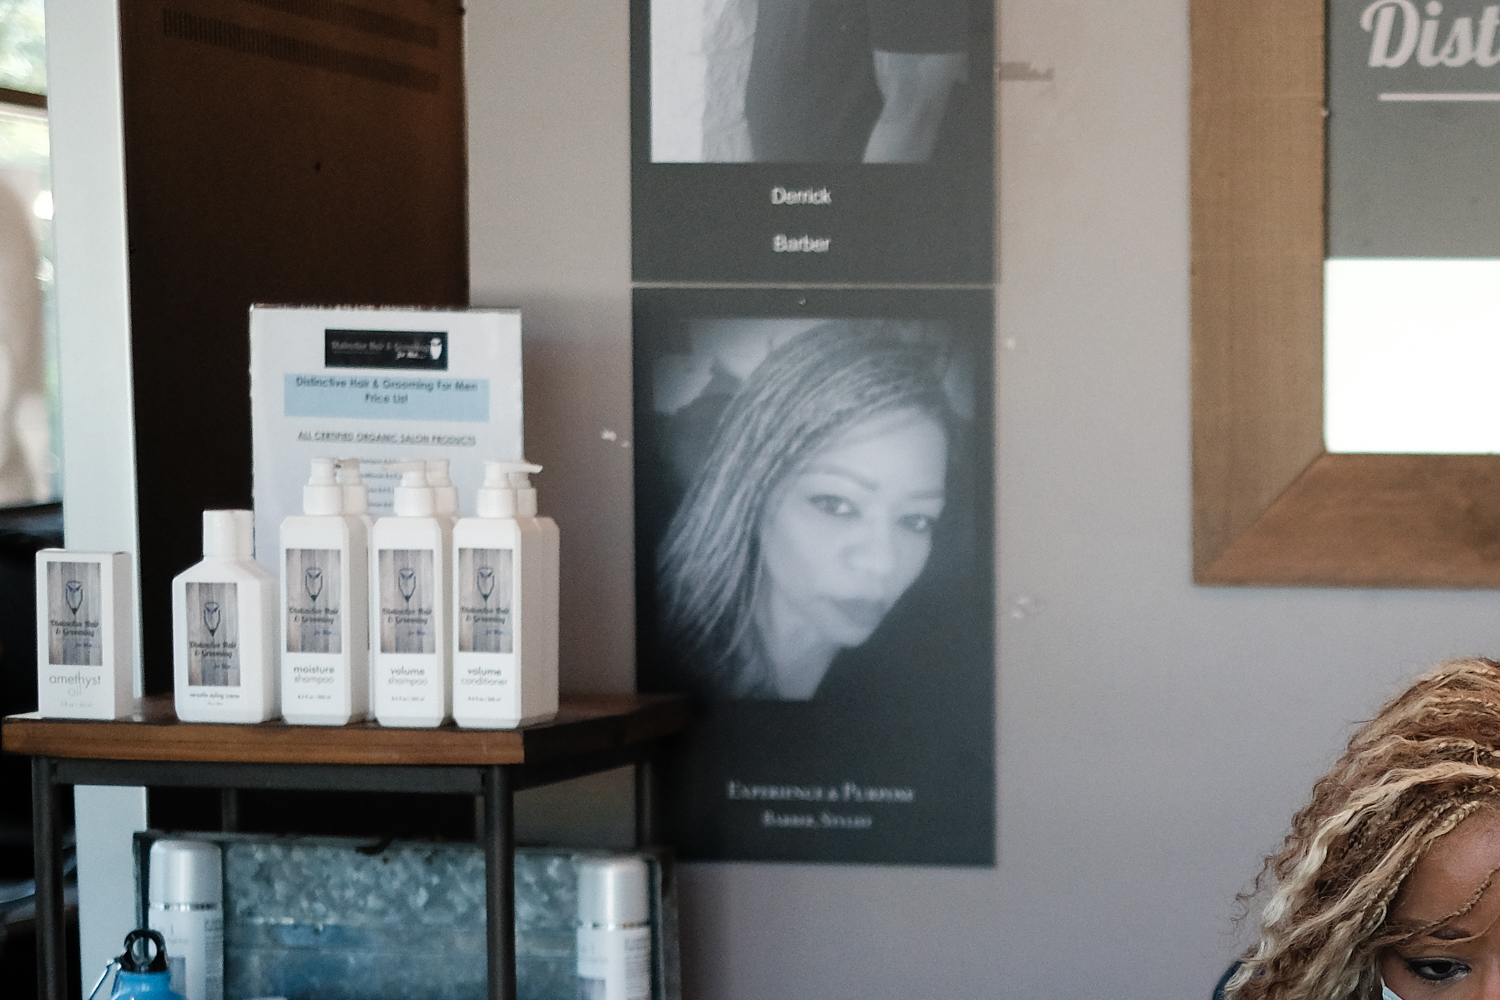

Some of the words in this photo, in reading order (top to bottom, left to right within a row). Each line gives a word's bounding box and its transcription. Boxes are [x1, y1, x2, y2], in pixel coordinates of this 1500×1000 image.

[771, 186, 832, 205] Derrick
[772, 233, 832, 253] Barber
[296, 376, 346, 388] Distinctive
[350, 377, 368, 389] Hair
[455, 380, 477, 391] Men
[293, 664, 335, 673] moisture
[390, 666, 425, 675] volume
[467, 666, 502, 675] volume
[49, 671, 101, 689] amethyst
